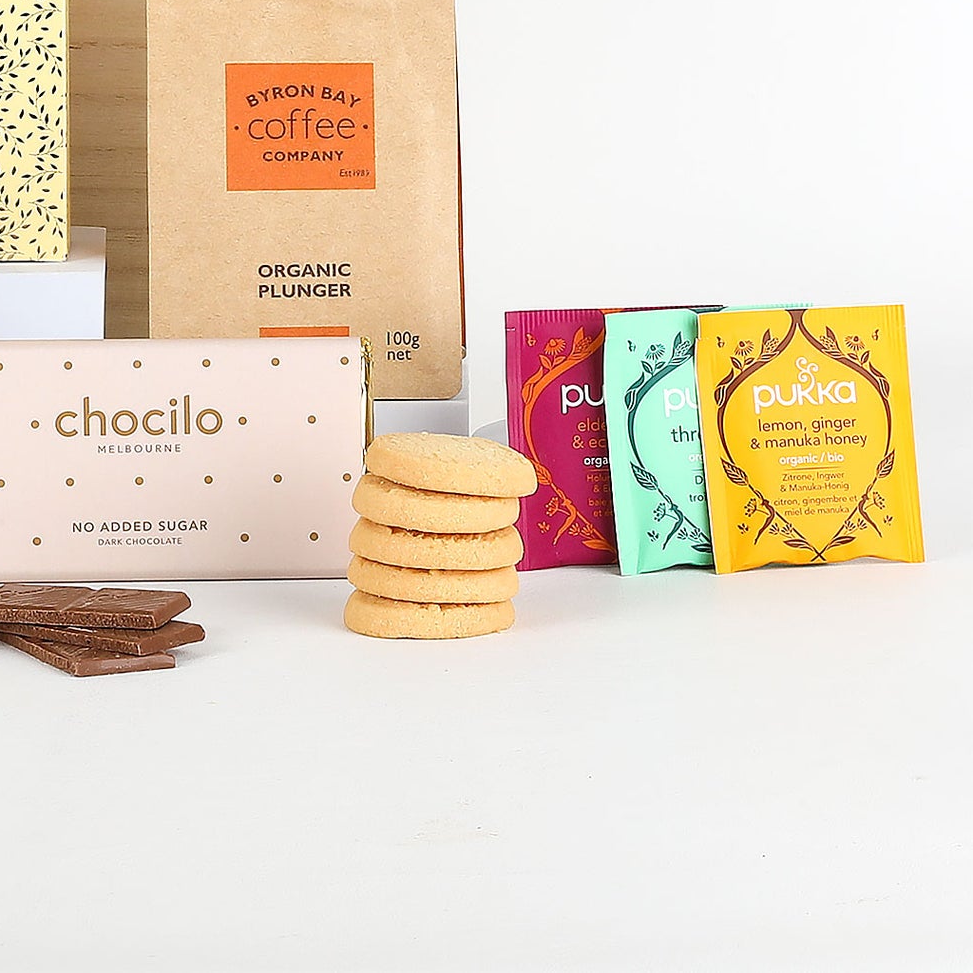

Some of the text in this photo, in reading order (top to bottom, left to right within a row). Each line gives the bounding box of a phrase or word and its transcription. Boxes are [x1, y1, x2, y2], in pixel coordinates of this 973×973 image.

[246, 84, 361, 108] BYRON BAY
[248, 108, 356, 139] coffee
[262, 151, 344, 162] COMPANY
[258, 263, 352, 278] ORGANIC
[258, 283, 352, 298] PLUNGER
[387, 331, 420, 349] 100g
[387, 349, 412, 361] net
[754, 365, 857, 414] pukka
[55, 394, 223, 437] chocilo
[758, 417, 856, 434] lemon, ginger
[97, 443, 182, 454] MELBOURNE
[572, 434, 584, 449] &
[750, 433, 867, 449] & manuka honey
[779, 451, 845, 467] organic / bio
[782, 472, 845, 481] Zitrone, Ingwer
[780, 482, 849, 492] & Manuka-Honig
[774, 498, 800, 506] citron,
[802, 495, 847, 505] gingembre
[804, 507, 817, 515] de
[818, 505, 849, 514] manuka
[72, 520, 208, 533] NO ADDED SUGAR
[98, 537, 183, 546] DARK CHOCOLATE
